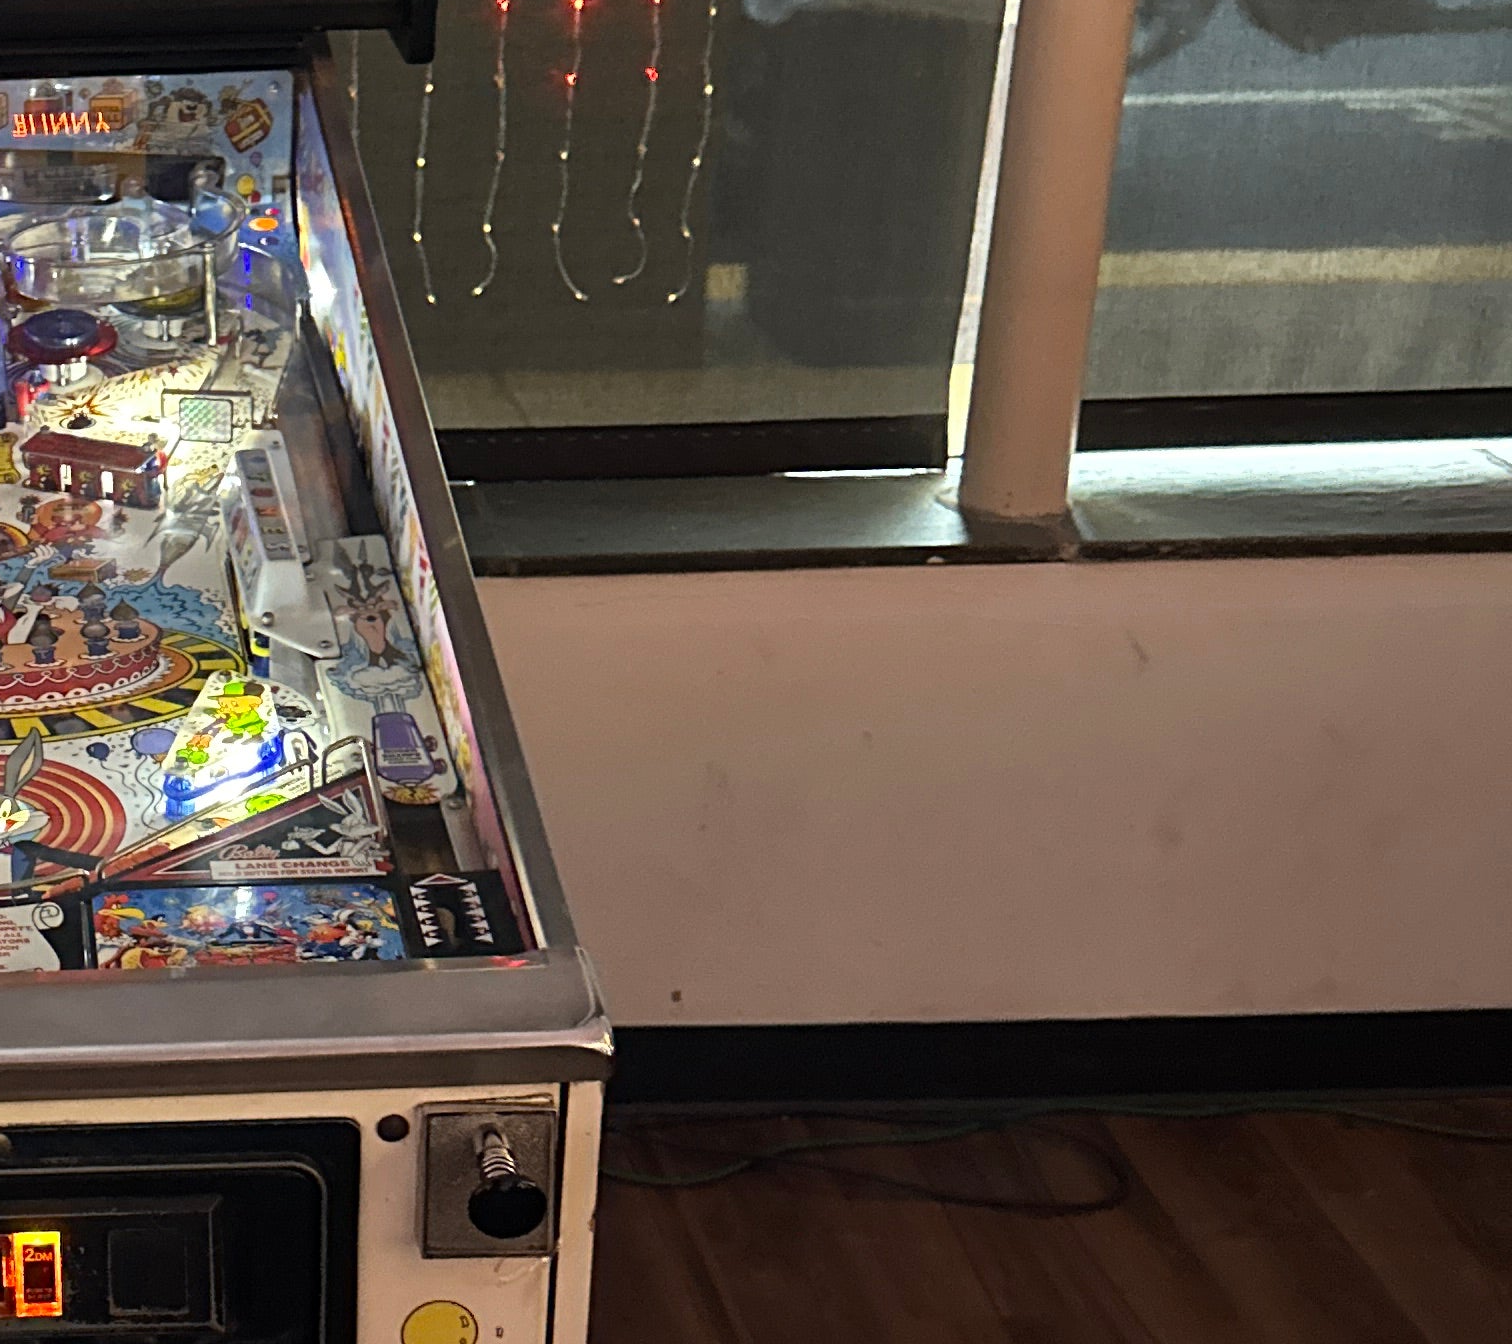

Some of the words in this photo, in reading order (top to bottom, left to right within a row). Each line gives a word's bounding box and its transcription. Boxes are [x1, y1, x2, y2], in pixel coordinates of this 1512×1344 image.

[218, 843, 281, 861] Bally
[234, 861, 278, 871] LANE
[281, 859, 351, 870] CHANGE
[244, 869, 279, 877] BUTTON
[334, 866, 369, 874] REPORT
[24, 1247, 54, 1262] 2DM
